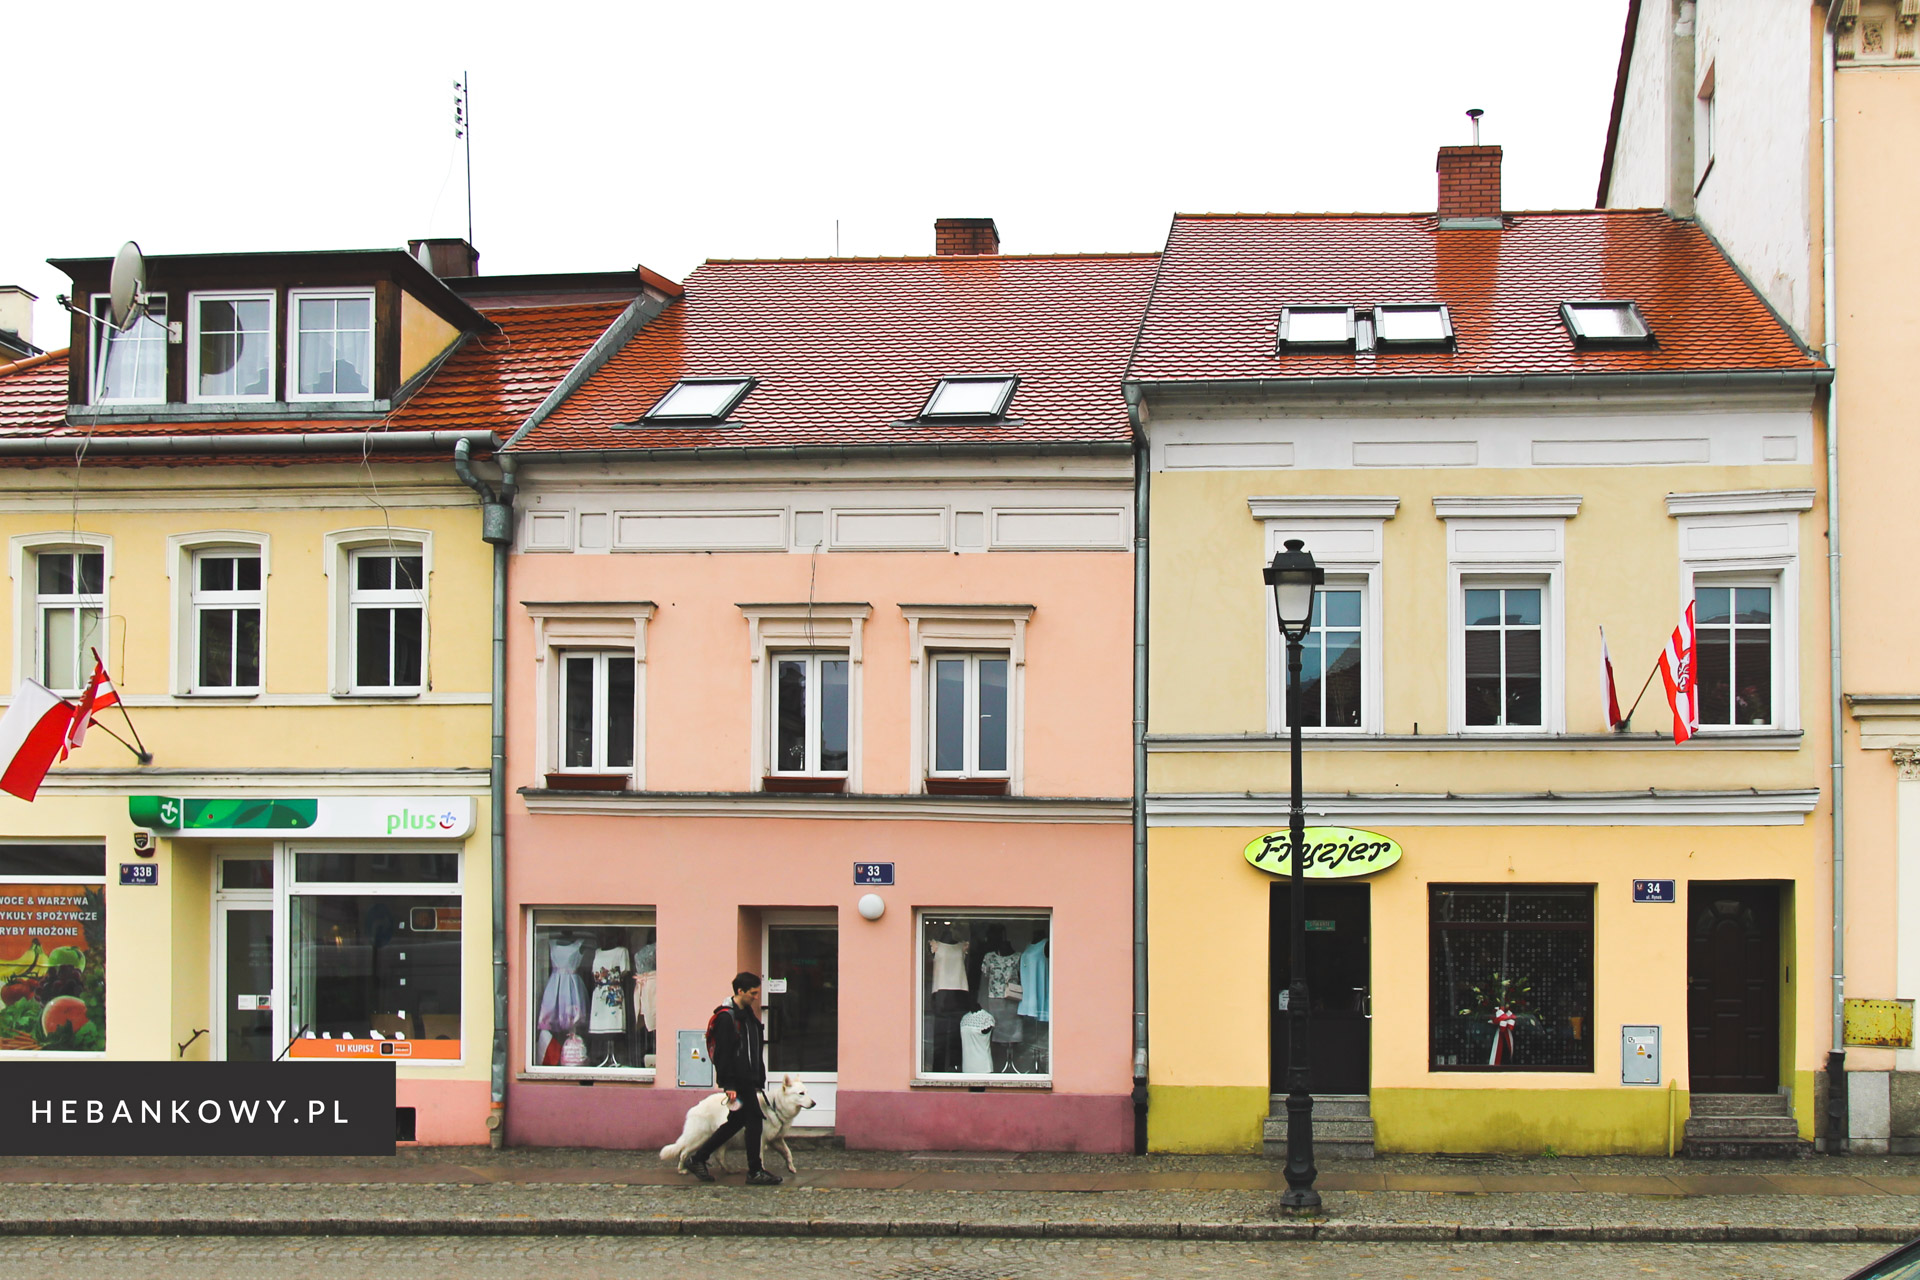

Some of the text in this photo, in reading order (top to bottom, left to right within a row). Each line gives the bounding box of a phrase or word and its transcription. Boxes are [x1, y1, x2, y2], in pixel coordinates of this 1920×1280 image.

[387, 808, 436, 835] plus
[133, 866, 152, 877] 33B
[867, 865, 880, 876] 33
[1647, 882, 1661, 894] 34
[27, 896, 34, 905] &
[37, 896, 89, 905] WARZYWA
[36, 910, 97, 921] SPOŻYWCZE
[0, 925, 78, 936] RYBY MROŻONE
[336, 1044, 374, 1053] TU KUPISZ
